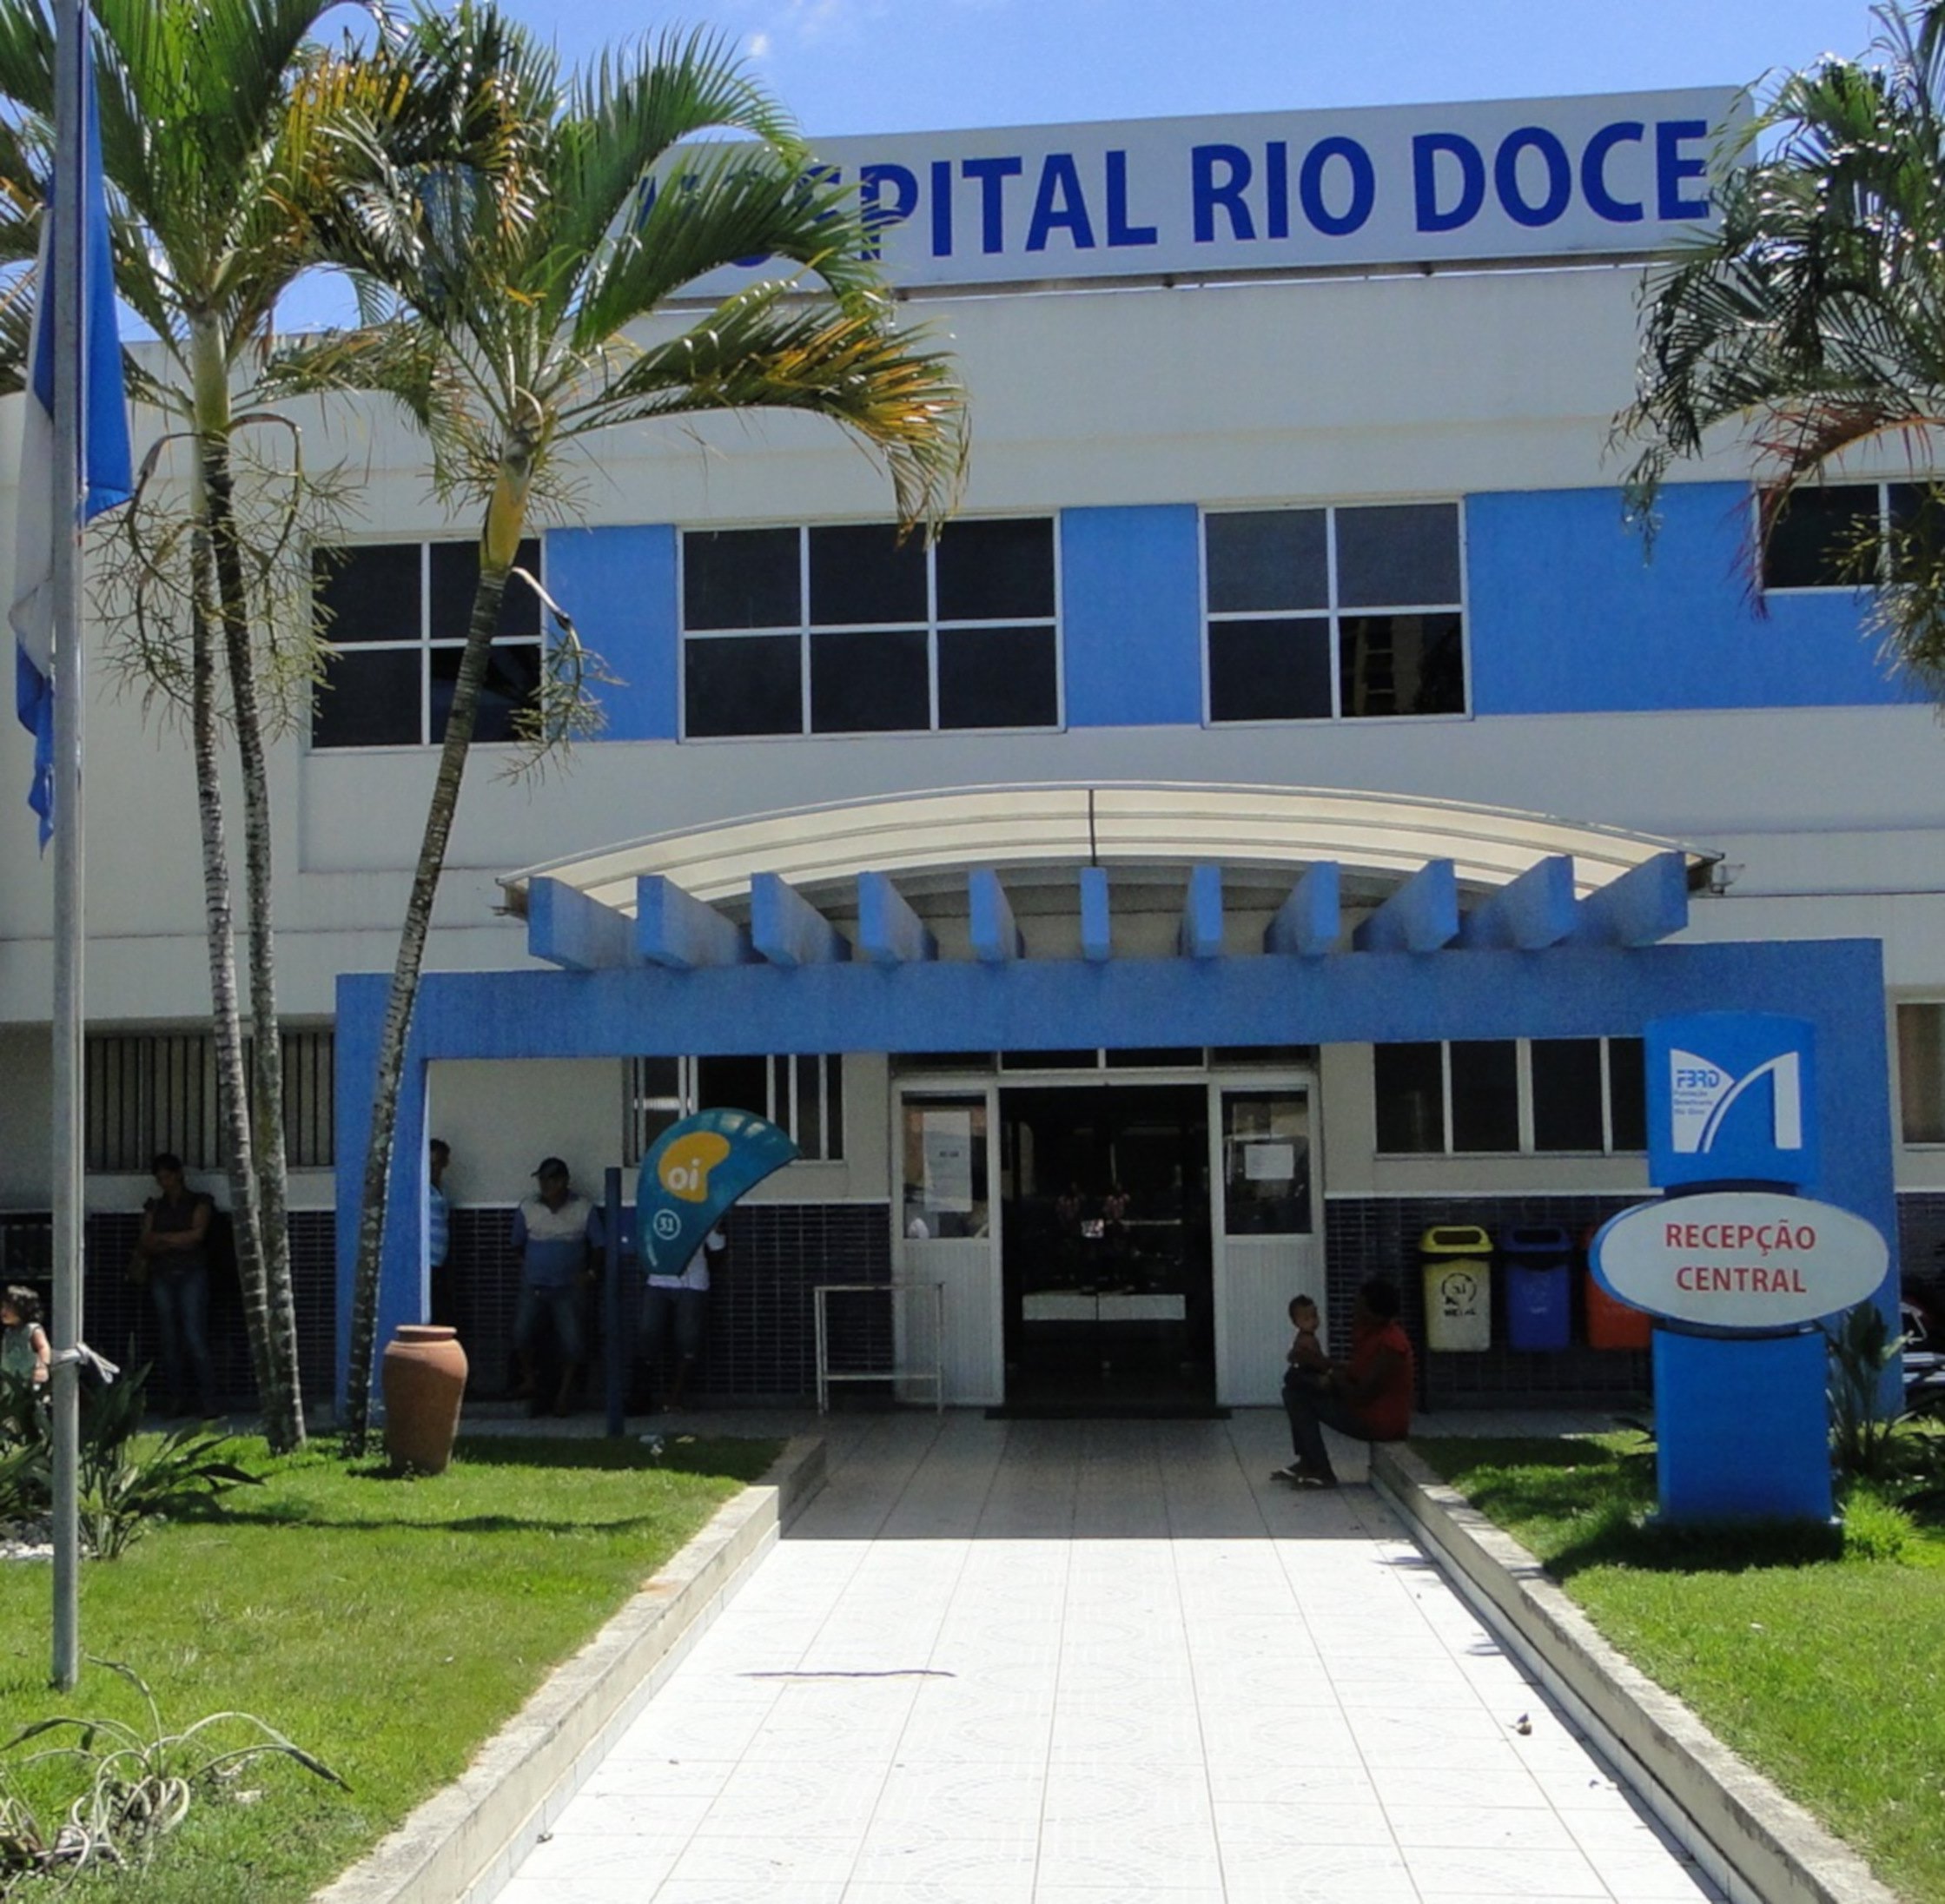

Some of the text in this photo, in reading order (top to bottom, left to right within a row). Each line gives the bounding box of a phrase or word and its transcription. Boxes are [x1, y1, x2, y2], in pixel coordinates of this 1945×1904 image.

[1191, 136, 1375, 242] RIO
[1412, 120, 1710, 233] DOCE
[668, 1157, 700, 1191] oi
[1665, 1219, 1816, 1256] RECEPÇÃO
[1676, 1266, 1807, 1292] CENTRAL
